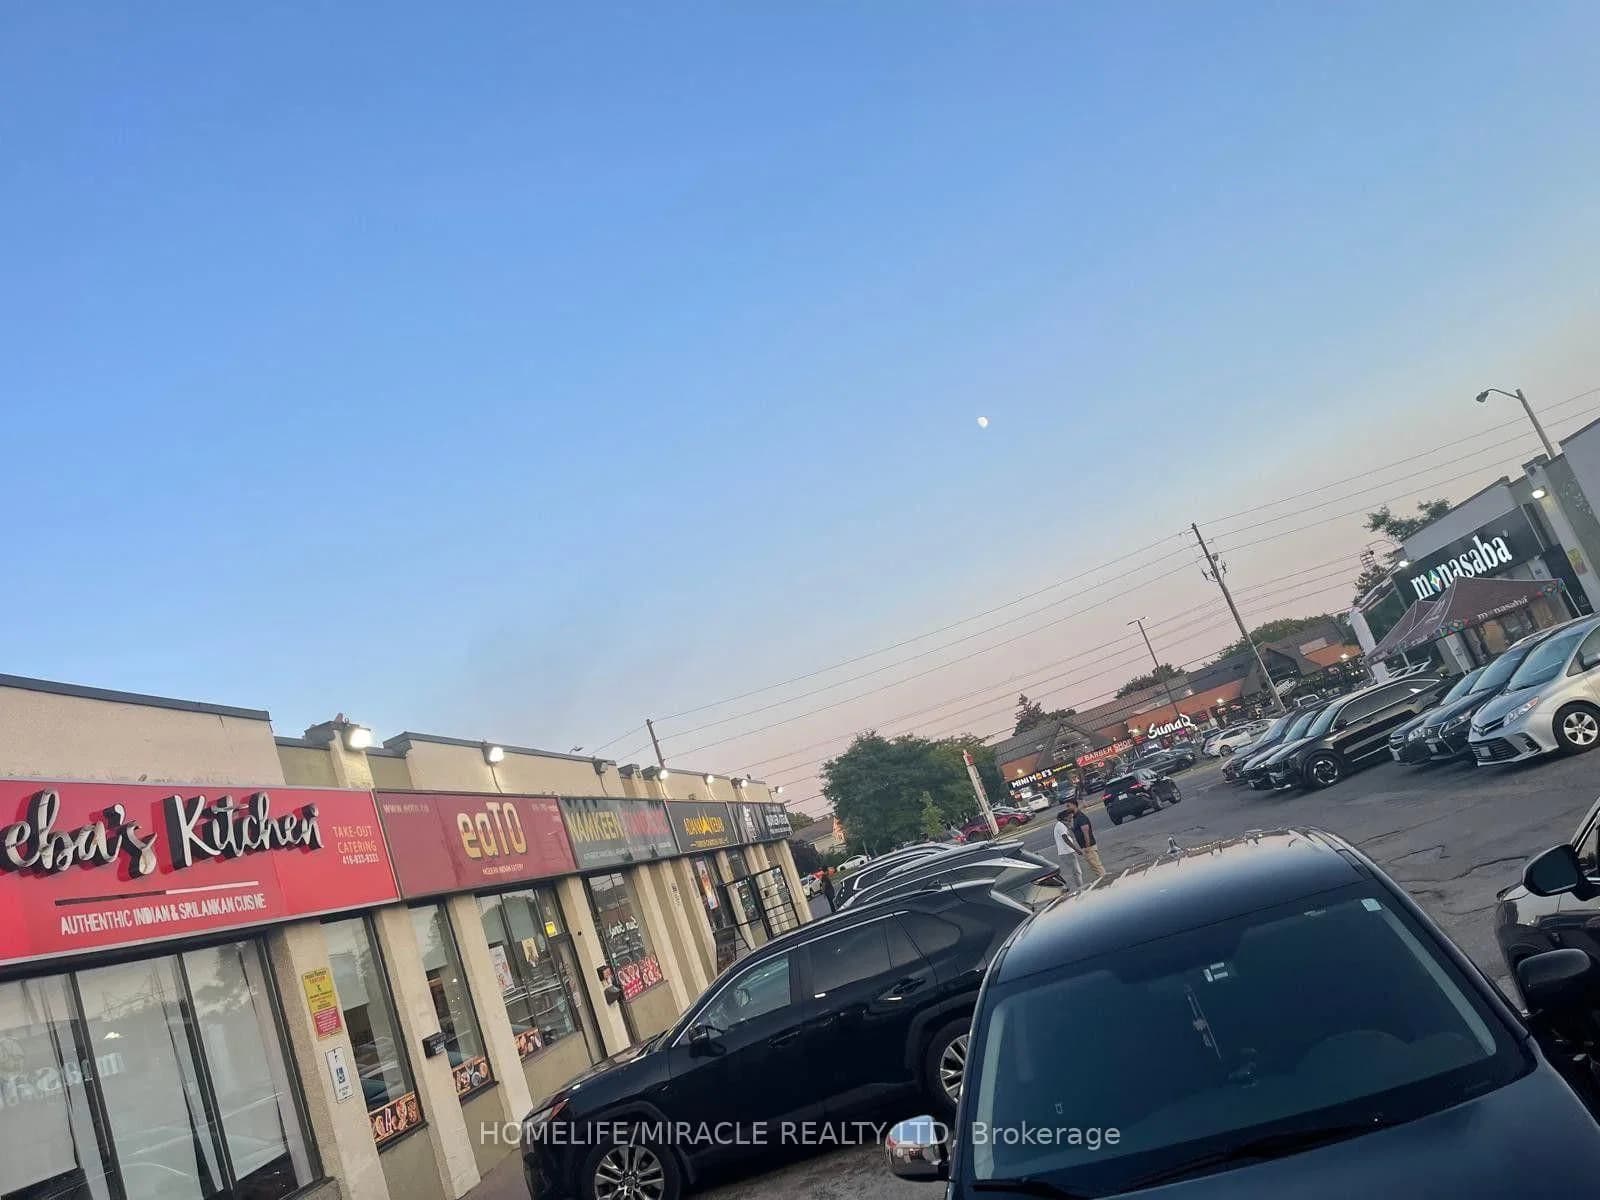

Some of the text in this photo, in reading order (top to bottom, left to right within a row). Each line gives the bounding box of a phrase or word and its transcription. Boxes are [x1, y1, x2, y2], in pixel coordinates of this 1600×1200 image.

[165, 791, 324, 868] Kitchen
[331, 825, 373, 839] TAKE-OUT
[337, 839, 378, 854] CATERING
[134, 904, 173, 926] INDIAN
